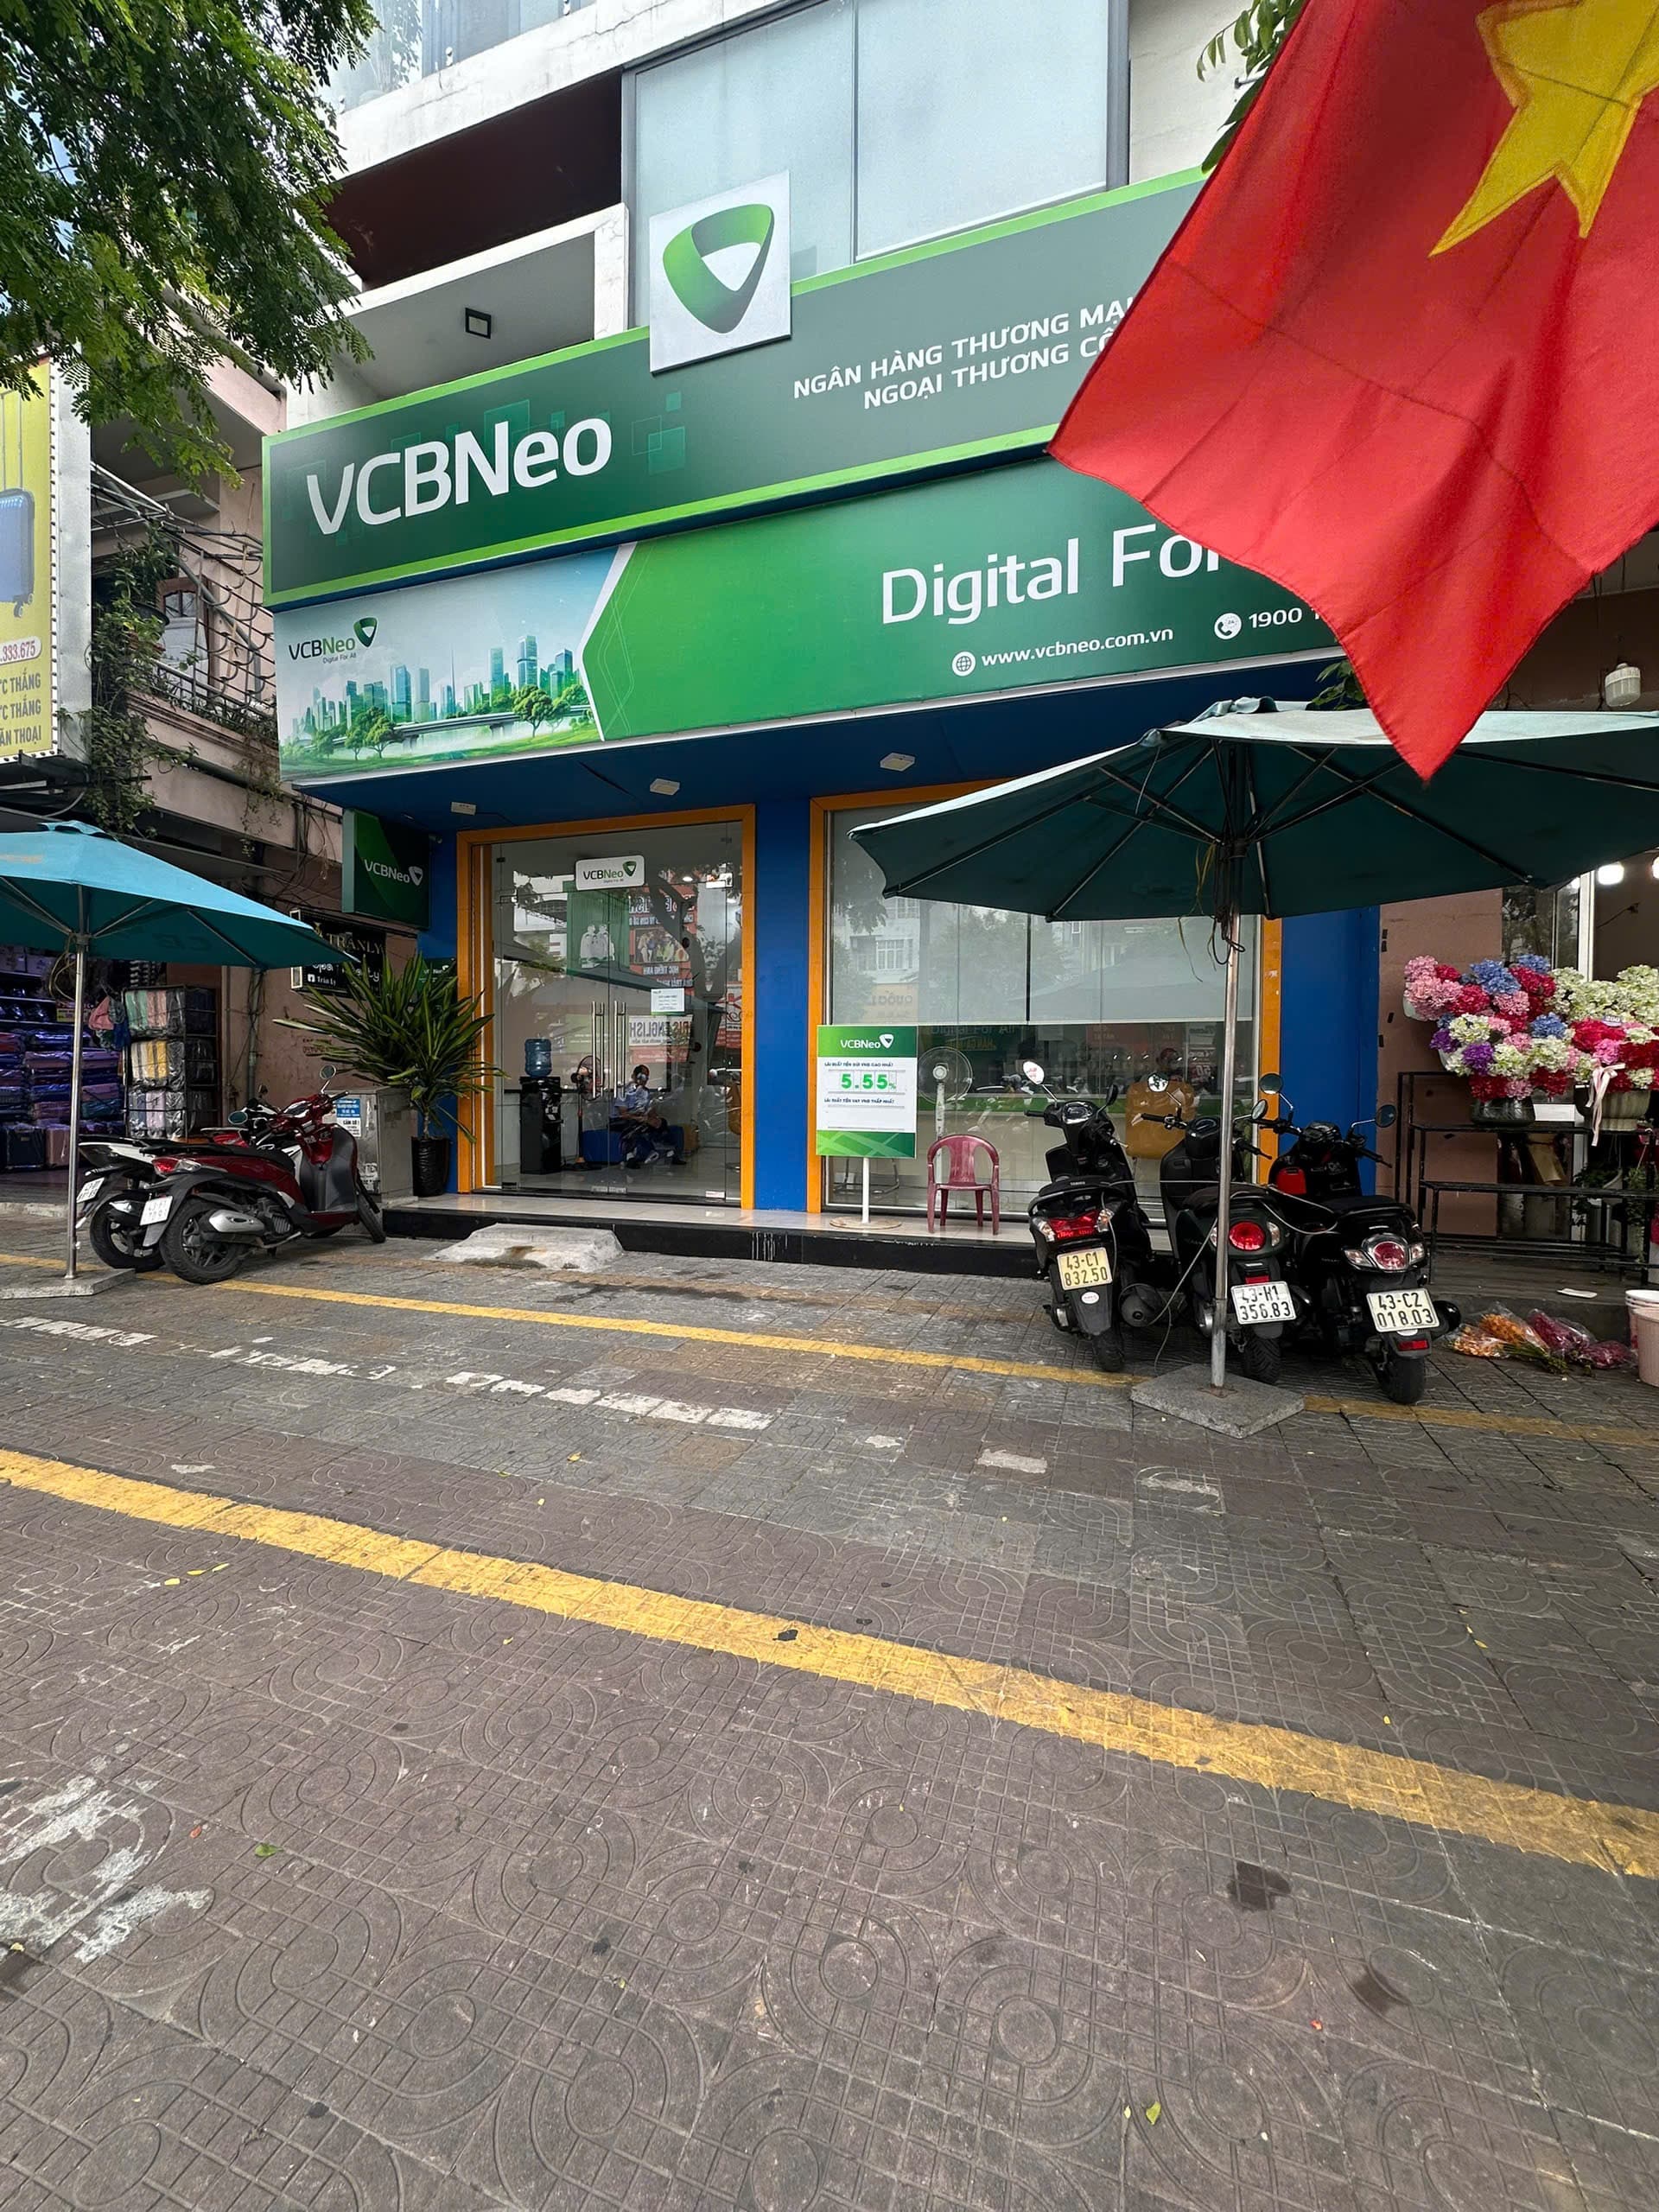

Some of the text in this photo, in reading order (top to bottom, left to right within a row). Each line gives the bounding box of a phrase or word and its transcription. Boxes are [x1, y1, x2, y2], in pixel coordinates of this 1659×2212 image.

[794, 365, 861, 398] NGÂN
[871, 345, 943, 379] HÀNG
[951, 313, 1069, 359] THƯƠNG
[864, 373, 943, 410] NGOẠI
[951, 344, 1069, 388] THƯƠNG
[307, 418, 612, 535] VCBNeo
[883, 537, 1079, 625] Digital
[1249, 607, 1302, 628] 1900
[289, 637, 355, 660] VCBNeo
[982, 628, 1173, 666] www.vcbneo.com.vn
[10, 668, 41, 693] THẮNG
[10, 695, 41, 719] THẮNG
[14, 725, 41, 744] THOẠI
[364, 859, 410, 883] VCBNeo
[583, 869, 623, 880] VCBNeo
[840, 1039, 880, 1049] VCBNeo
[1066, 1251, 1099, 1269] 43-C1
[1065, 1267, 1108, 1286] 832.50
[1239, 1301, 1291, 1320] 356.83
[1378, 1293, 1422, 1310] 43-C2
[1376, 1308, 1433, 1327] 018.03
